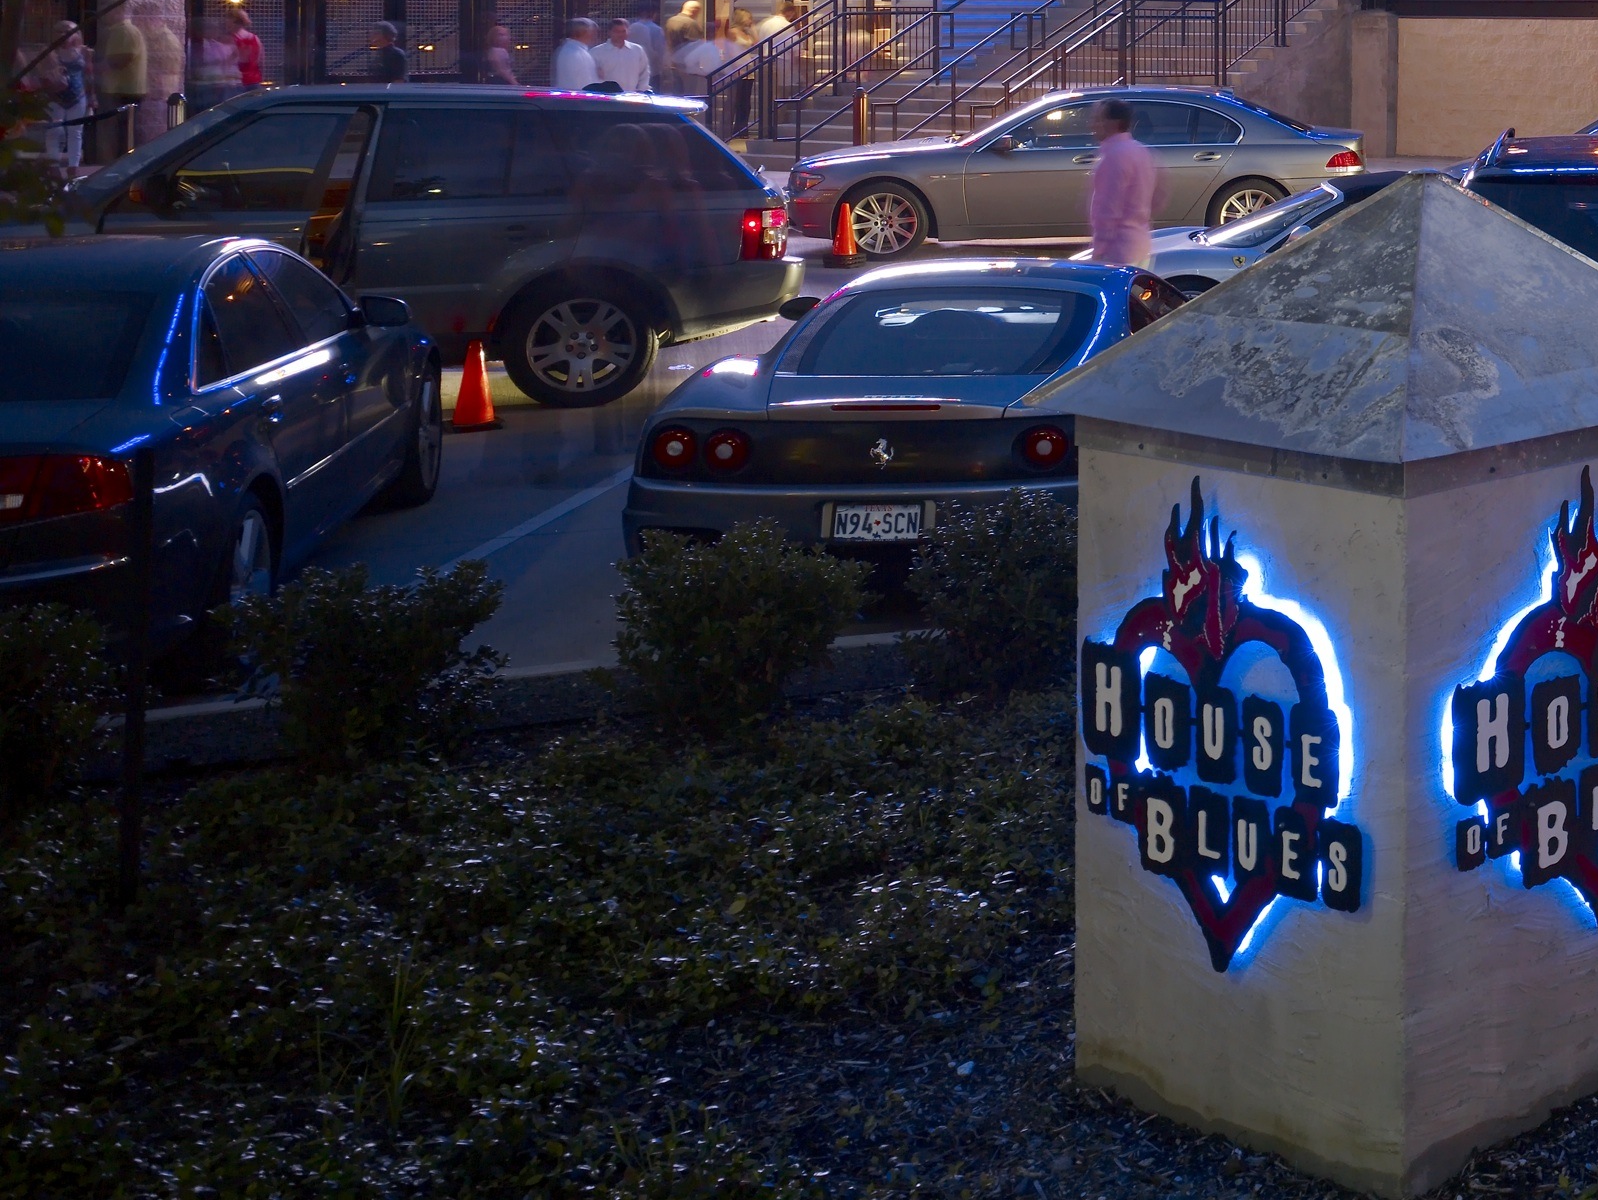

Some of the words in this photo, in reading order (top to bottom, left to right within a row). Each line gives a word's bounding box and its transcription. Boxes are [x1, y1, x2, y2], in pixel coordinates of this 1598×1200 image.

[864, 504, 893, 512] TEXAS
[1095, 660, 1322, 788] HOUSE
[1090, 777, 1129, 812] OF
[1146, 798, 1347, 894] BLUES
[1466, 817, 1511, 856] OF
